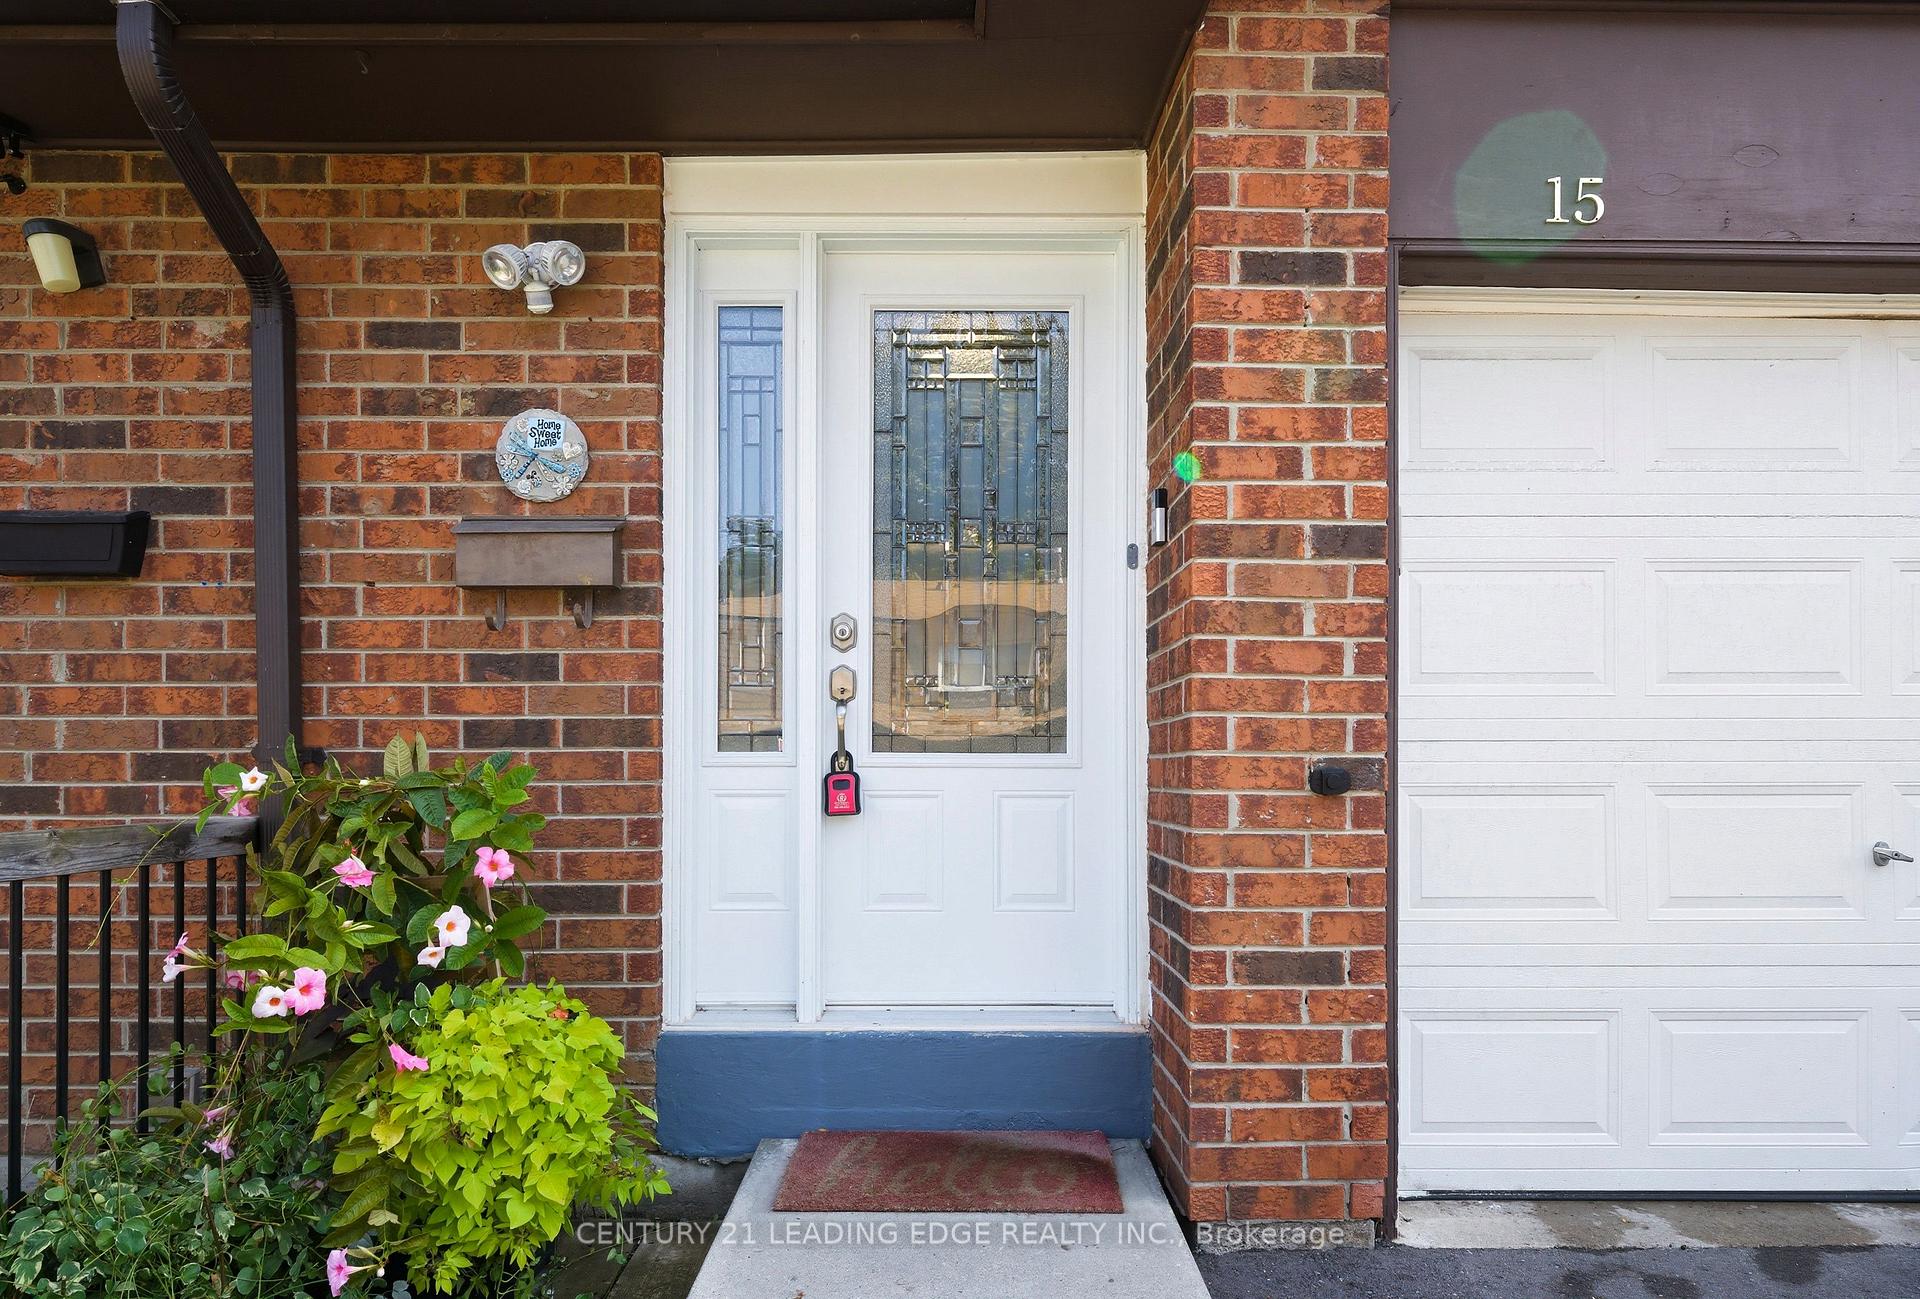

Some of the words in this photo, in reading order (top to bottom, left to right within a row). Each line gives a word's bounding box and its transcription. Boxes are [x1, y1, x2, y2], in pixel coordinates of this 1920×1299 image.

[1545, 176, 1605, 224] 15
[537, 419, 561, 430] Home
[529, 427, 561, 440] Sweet
[533, 438, 557, 448] Home
